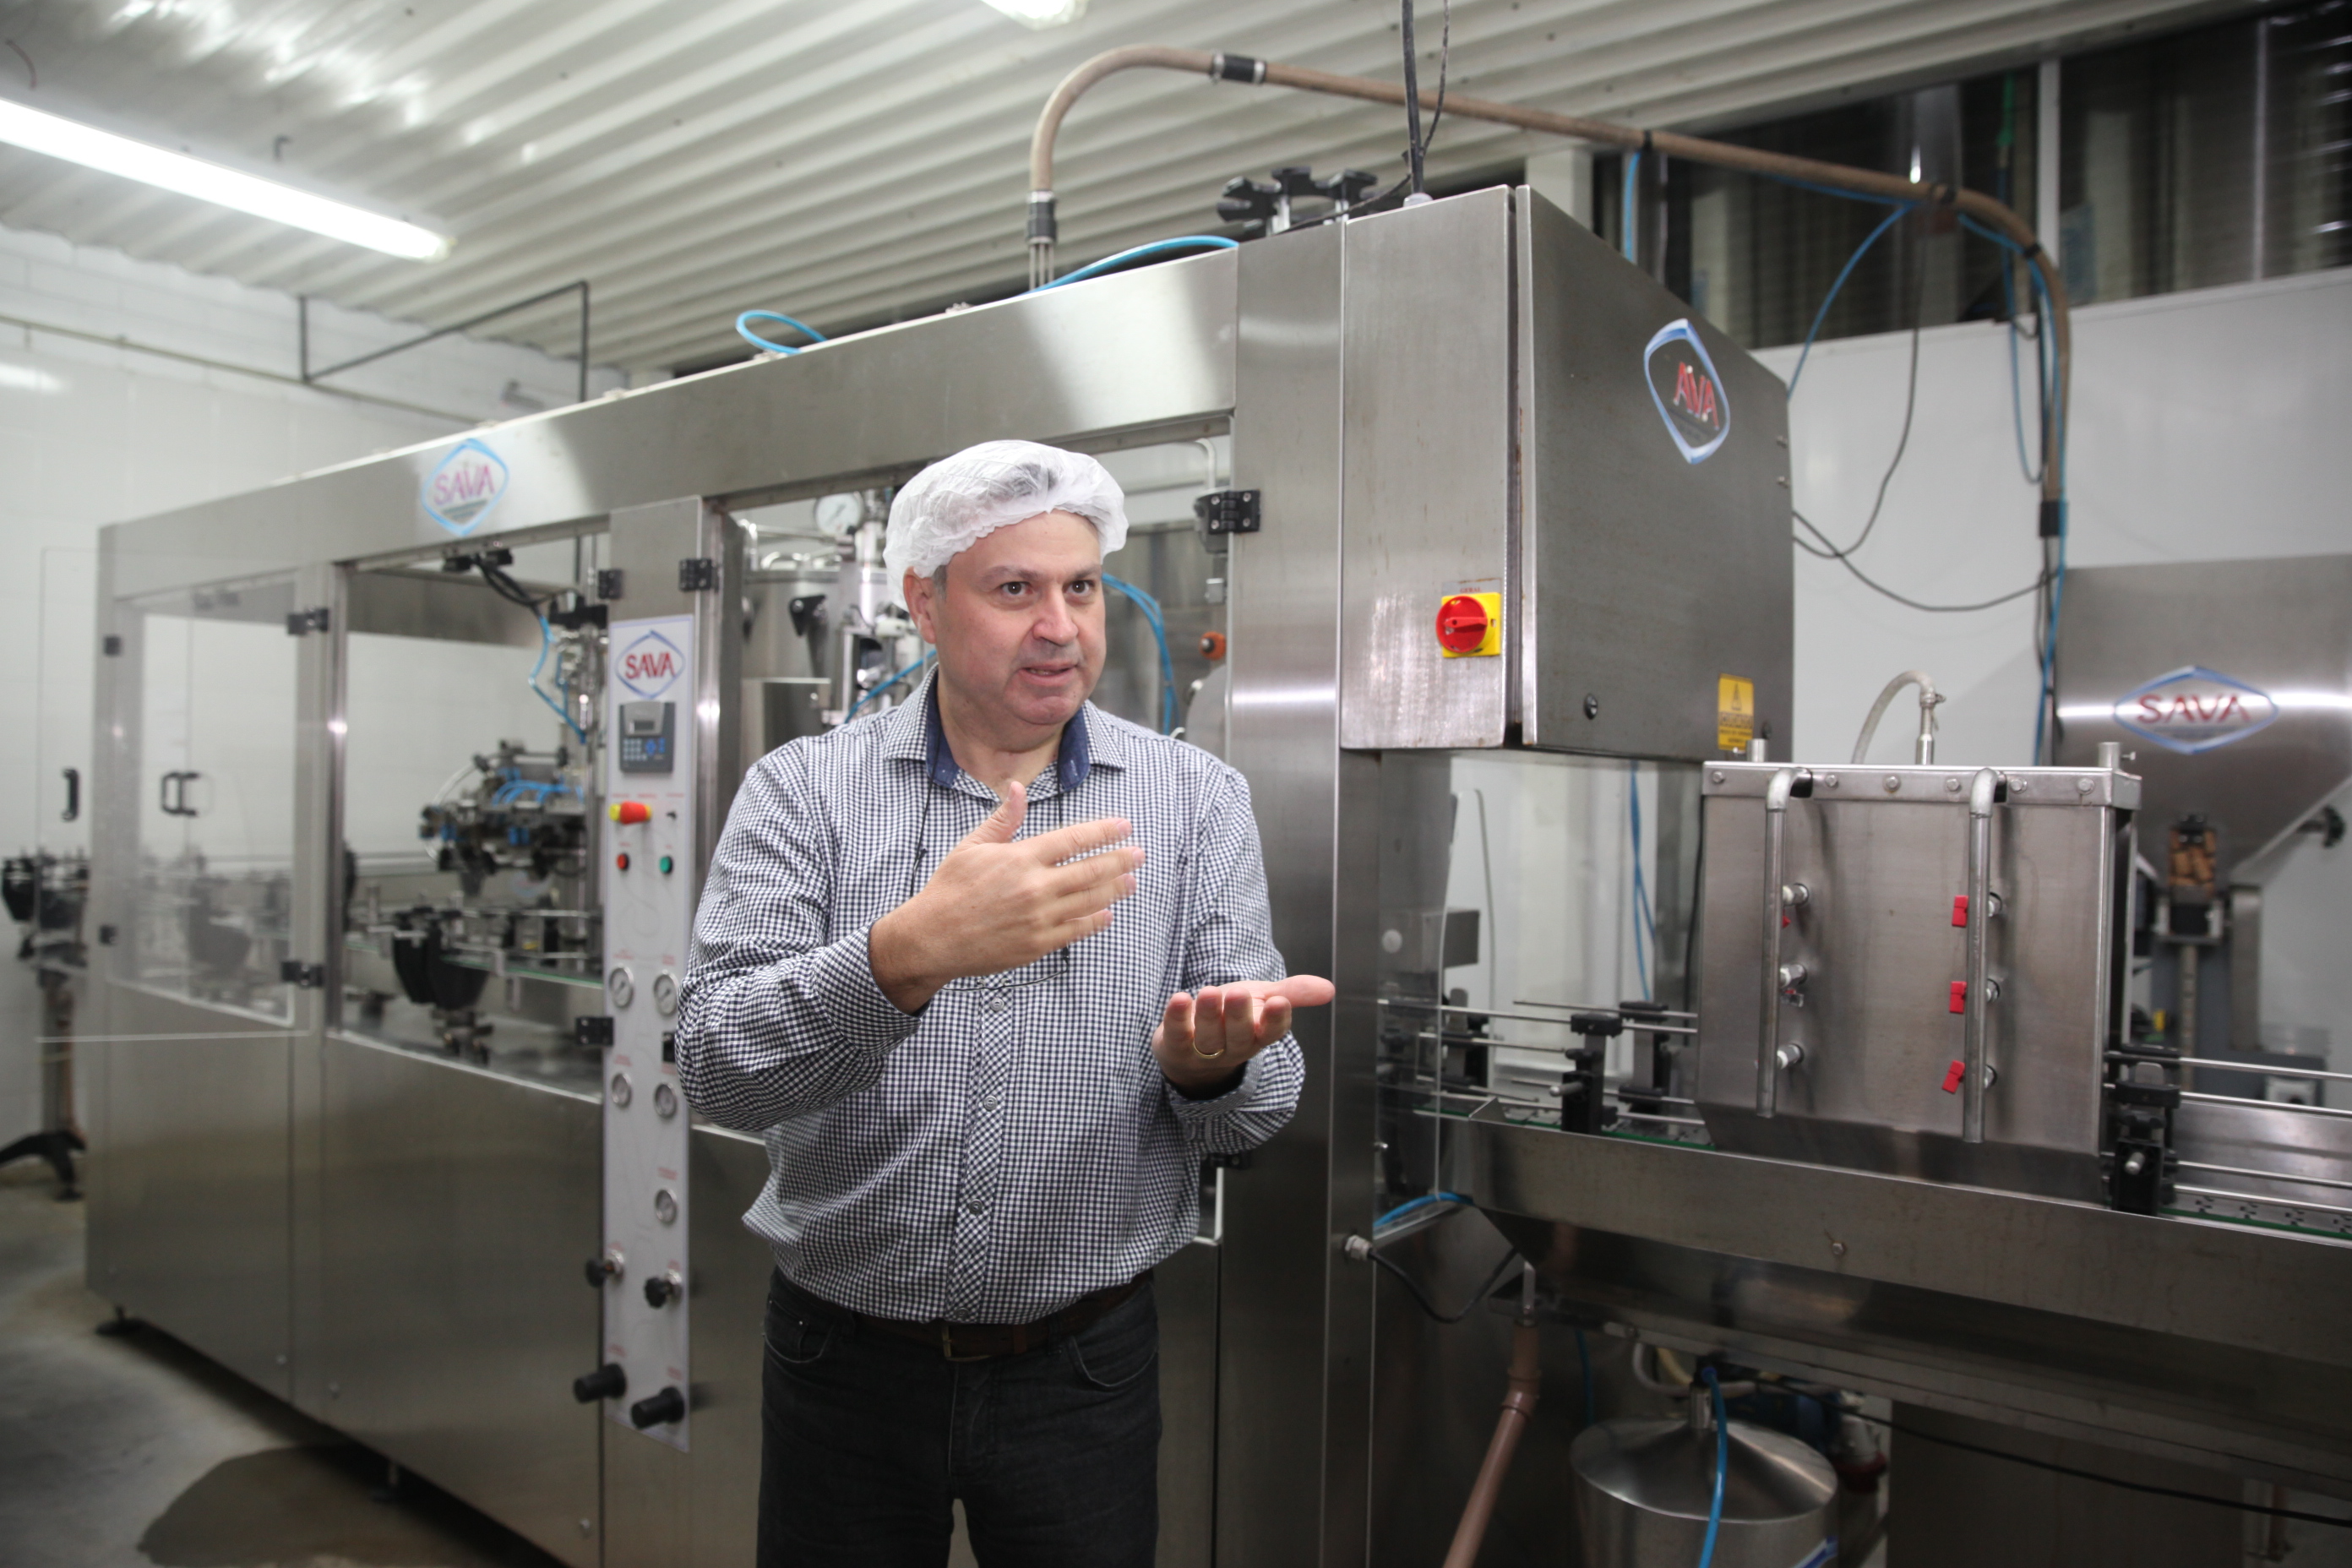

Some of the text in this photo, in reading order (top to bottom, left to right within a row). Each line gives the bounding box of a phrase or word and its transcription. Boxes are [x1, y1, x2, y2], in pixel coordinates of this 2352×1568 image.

[433, 464, 496, 505] SAVA
[624, 651, 677, 679] SAVA
[2137, 694, 2252, 724] SAVA
